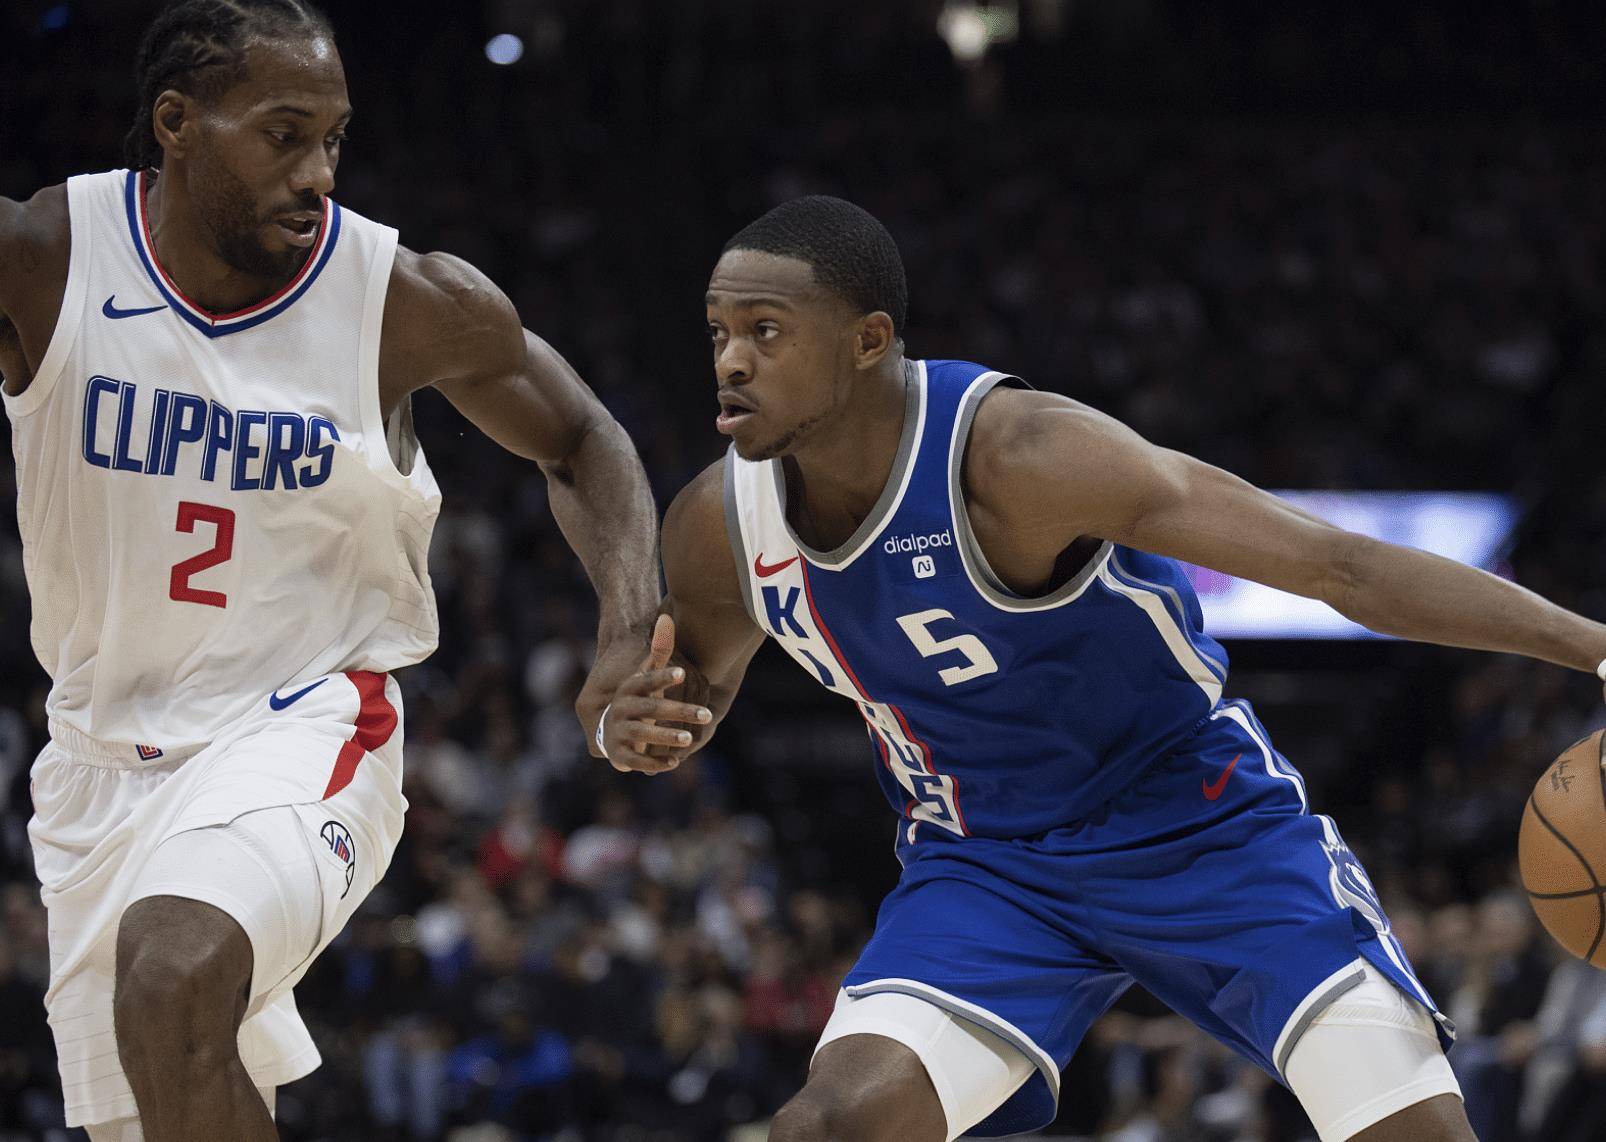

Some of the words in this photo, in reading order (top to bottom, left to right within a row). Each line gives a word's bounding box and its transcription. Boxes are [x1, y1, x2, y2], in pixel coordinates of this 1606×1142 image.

[82, 375, 341, 491] CLIPPERS
[169, 501, 236, 609] 2
[884, 529, 952, 553] dialpad
[896, 608, 998, 686] 5
[761, 586, 954, 822] KIS
